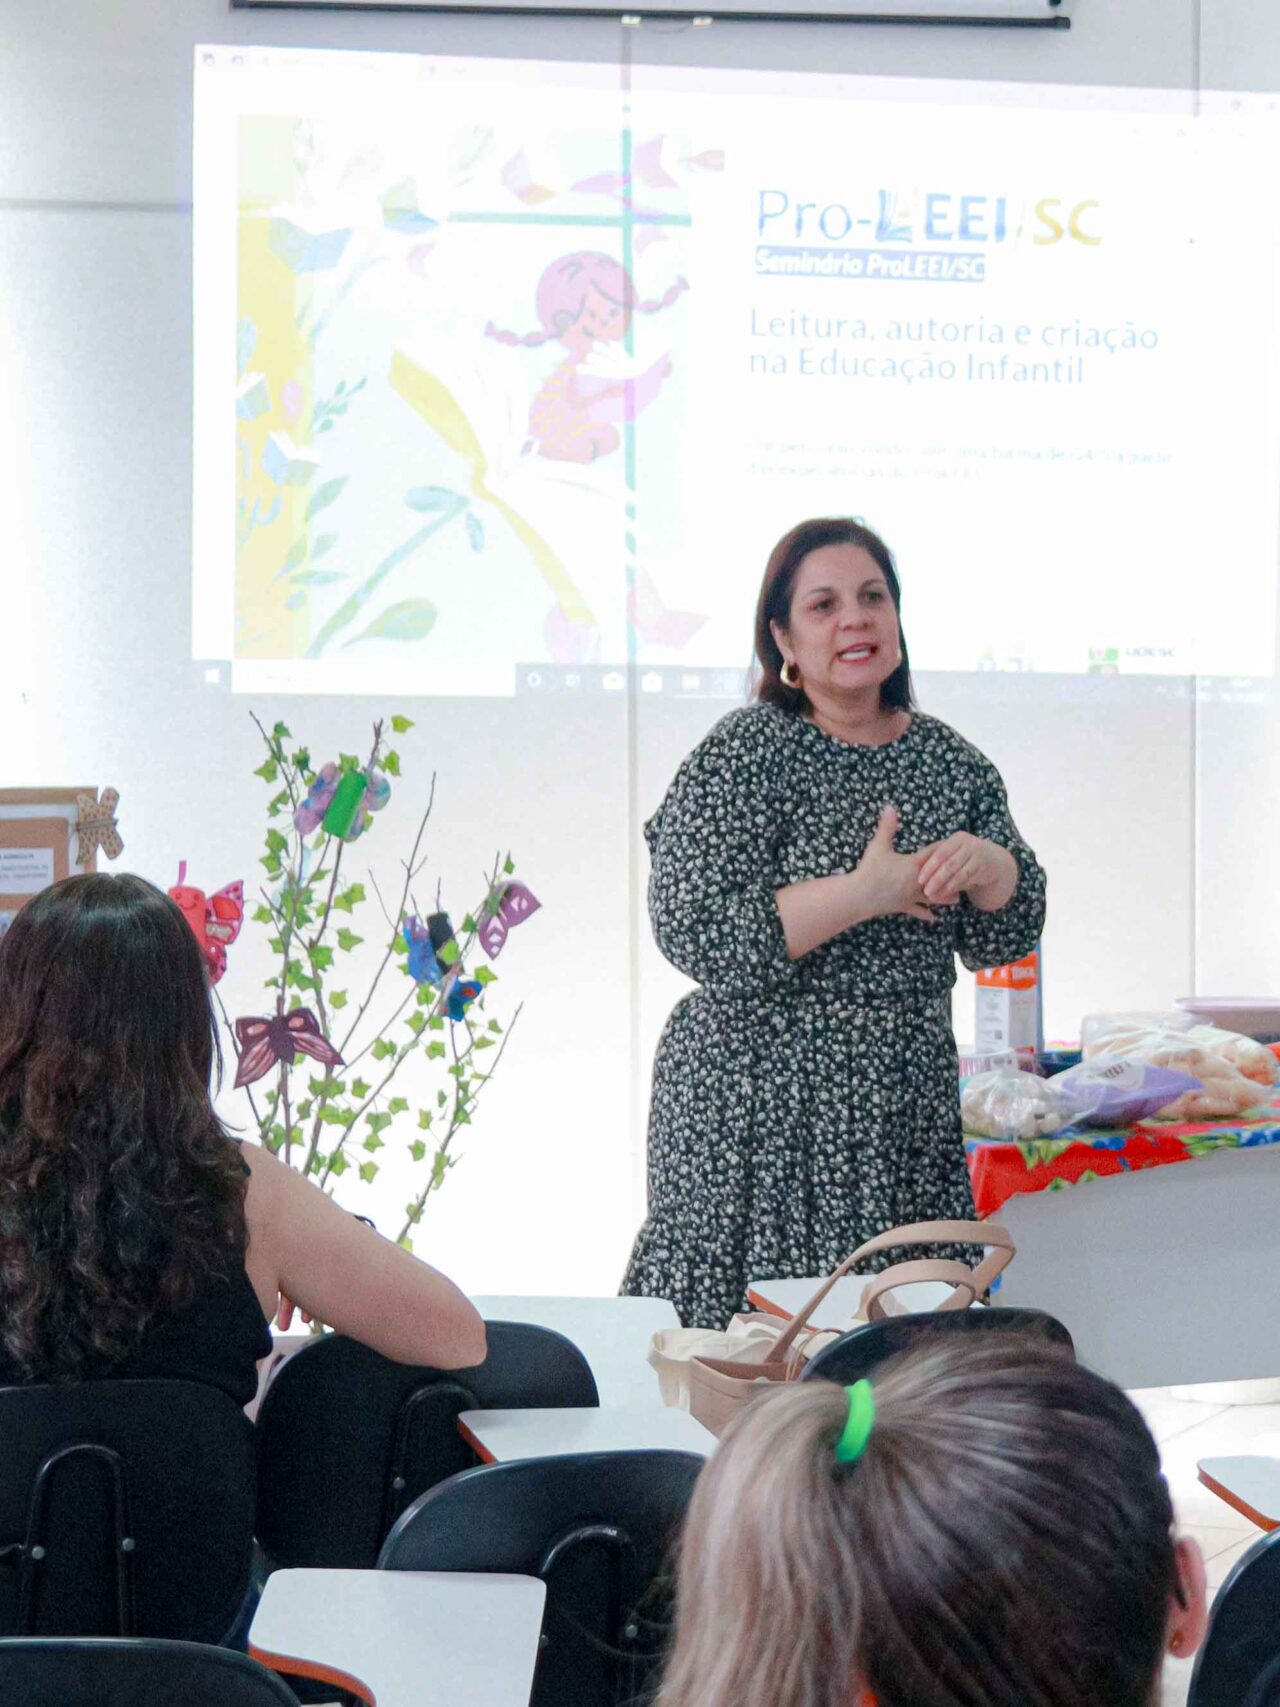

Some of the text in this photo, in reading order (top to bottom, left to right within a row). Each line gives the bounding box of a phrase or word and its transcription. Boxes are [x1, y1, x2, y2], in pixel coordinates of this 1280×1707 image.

[866, 251, 985, 281] ProLEEI/SC
[750, 307, 1159, 354] Leitura, autoria e criação
[750, 348, 1084, 385] na Educação Infantil
